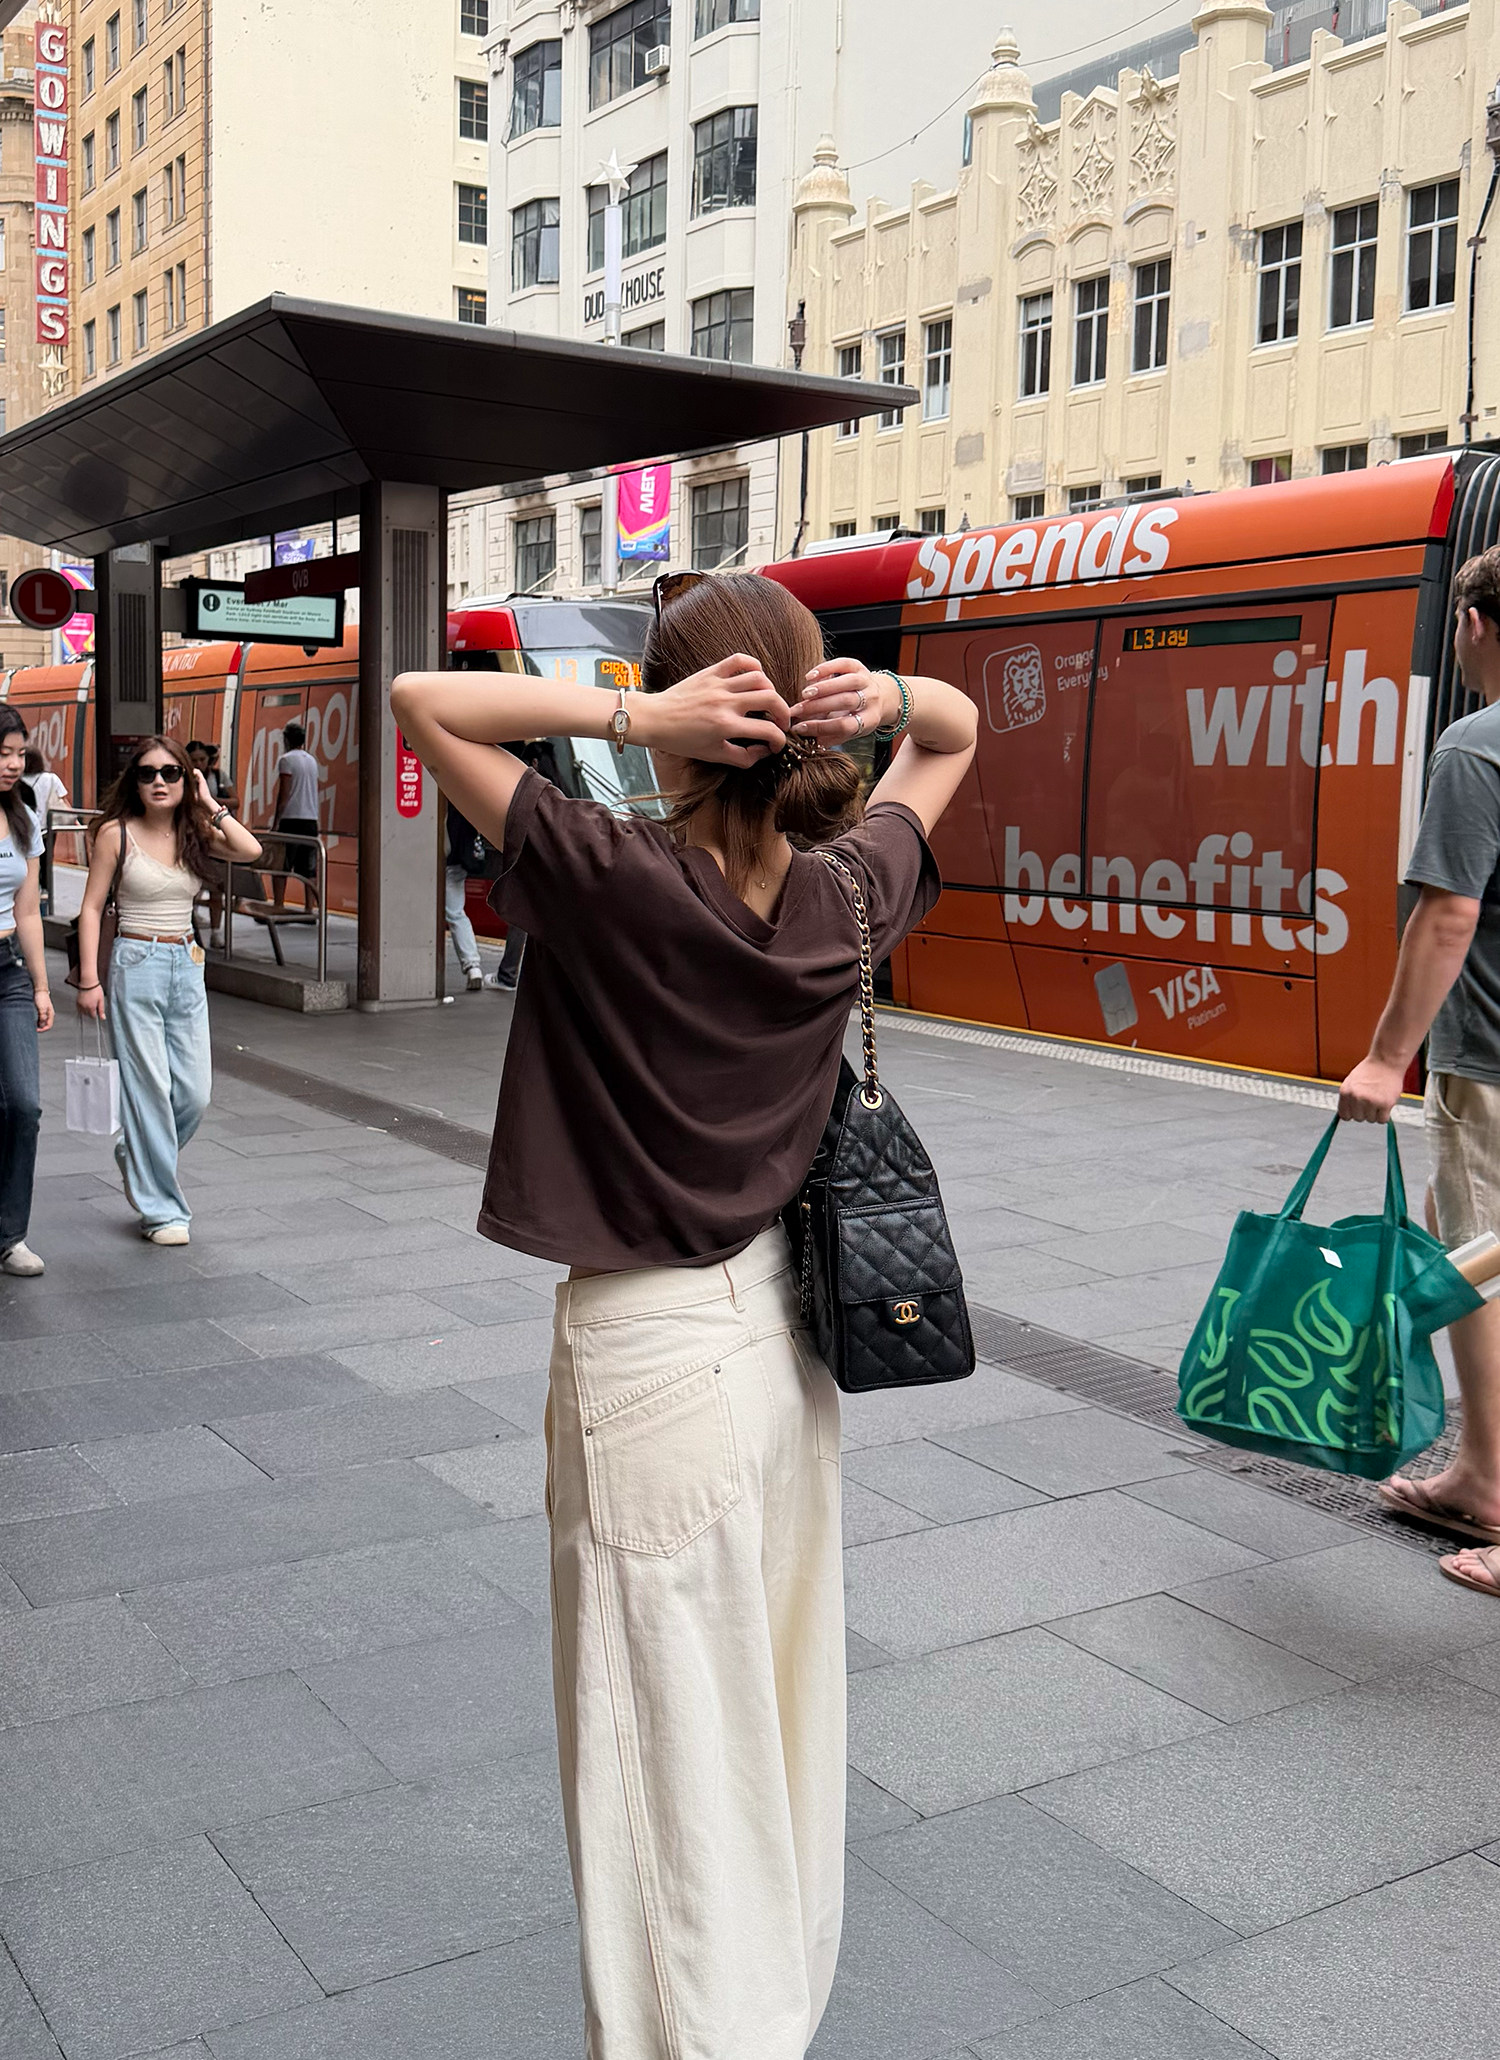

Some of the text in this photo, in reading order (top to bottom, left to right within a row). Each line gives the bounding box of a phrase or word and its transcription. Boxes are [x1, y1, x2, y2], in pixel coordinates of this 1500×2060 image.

[38, 29, 66, 341] GOWINGS
[34, 581, 57, 616] L
[292, 568, 309, 592] QVB
[906, 503, 1180, 621] Spends
[1132, 628, 1155, 650] L3
[242, 682, 359, 827] APROL
[1185, 649, 1399, 768] with
[1003, 825, 1350, 955] benefits
[1148, 966, 1222, 1021] VISA
